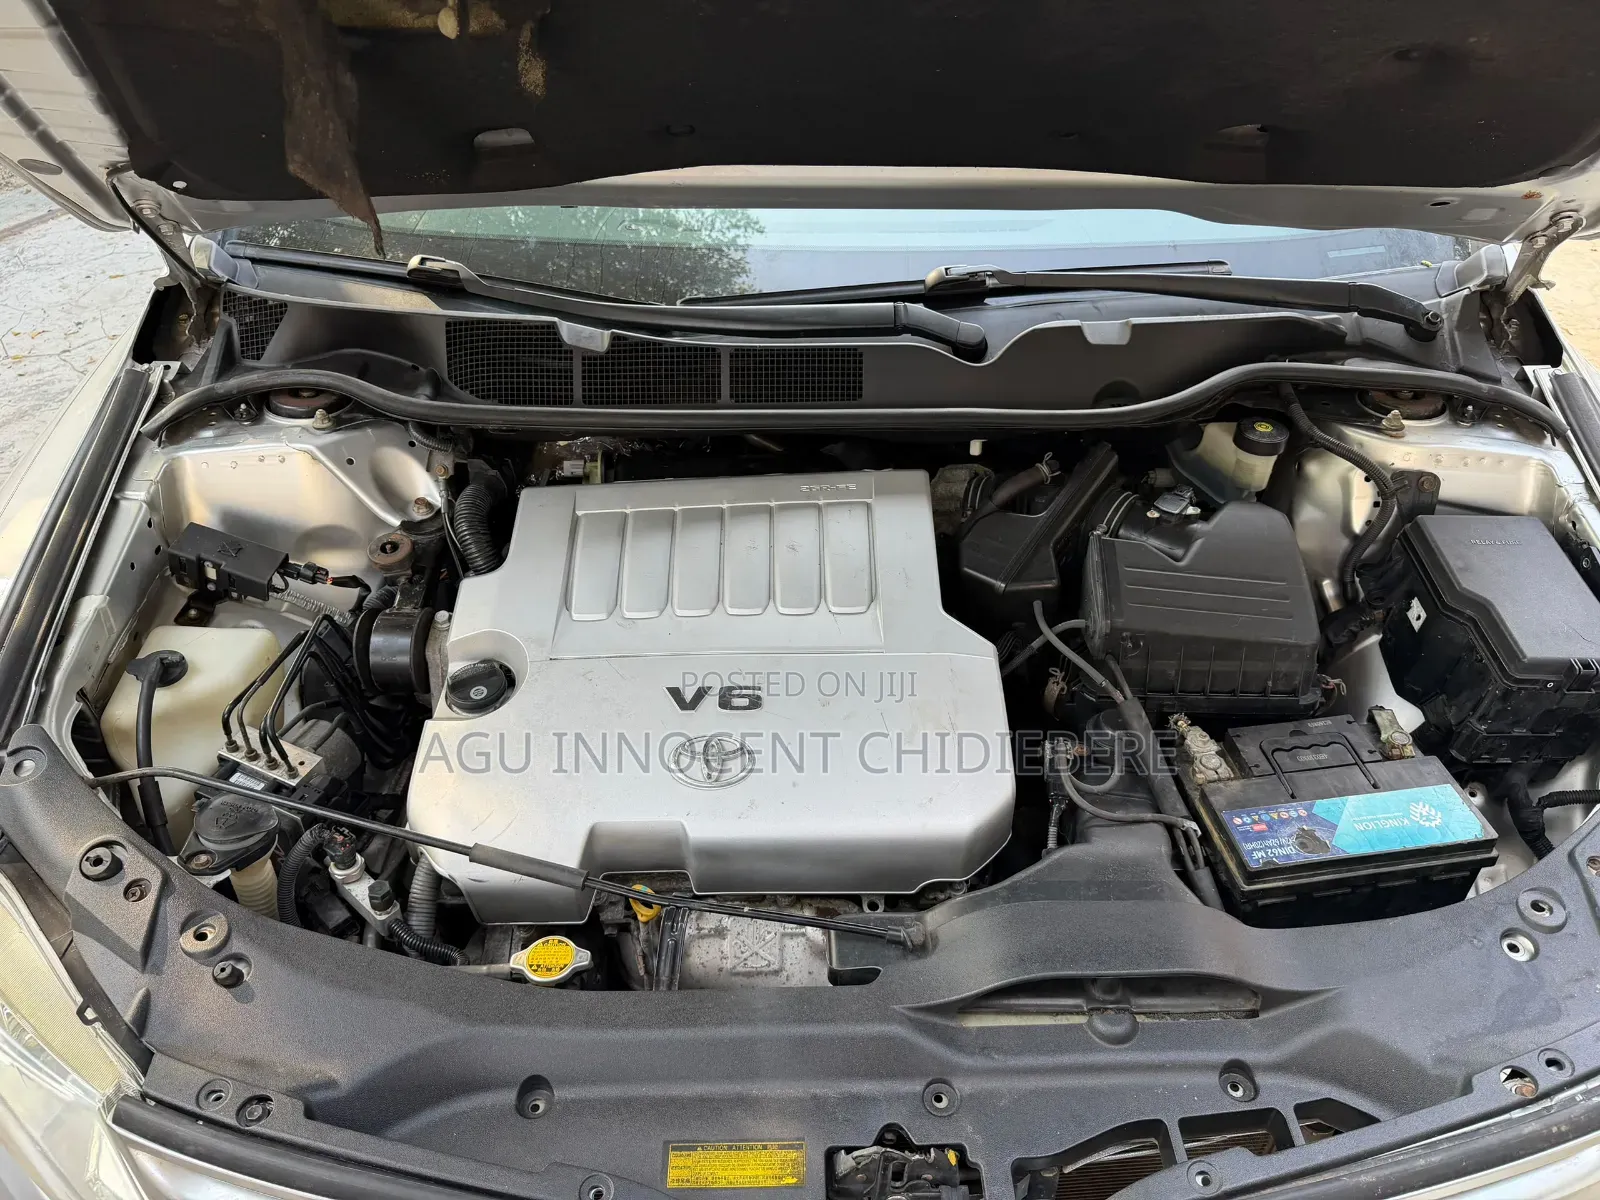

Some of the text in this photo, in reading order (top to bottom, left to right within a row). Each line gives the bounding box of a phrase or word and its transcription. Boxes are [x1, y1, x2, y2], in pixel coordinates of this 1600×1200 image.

[662, 684, 764, 713] V6
[1353, 817, 1410, 831] KINGLION
[1251, 845, 1297, 860] DIN62 MF
